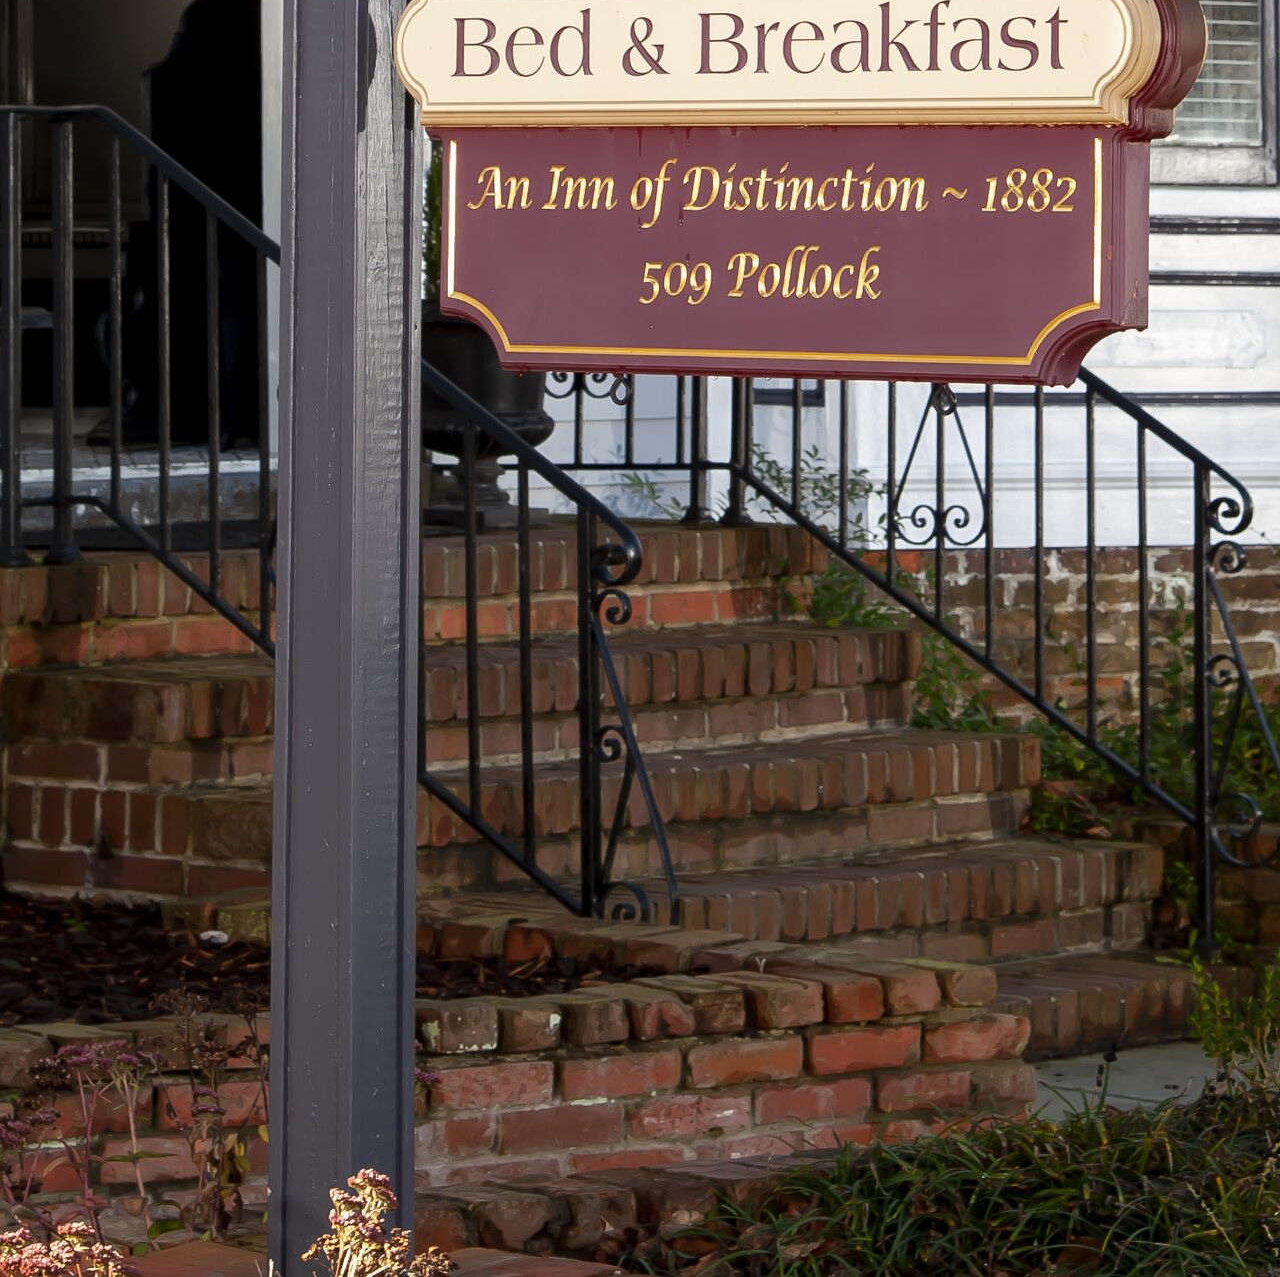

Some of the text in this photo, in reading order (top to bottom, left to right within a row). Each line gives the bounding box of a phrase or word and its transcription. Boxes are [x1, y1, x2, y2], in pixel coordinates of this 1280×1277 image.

[451, 0, 1070, 77] Bed & Breakfast
[467, 165, 533, 211] An
[541, 166, 617, 210] Inn
[629, 158, 678, 228] of
[682, 162, 930, 212] Distinction
[981, 167, 1077, 213] 1882
[638, 245, 882, 306] 509 Pollock
